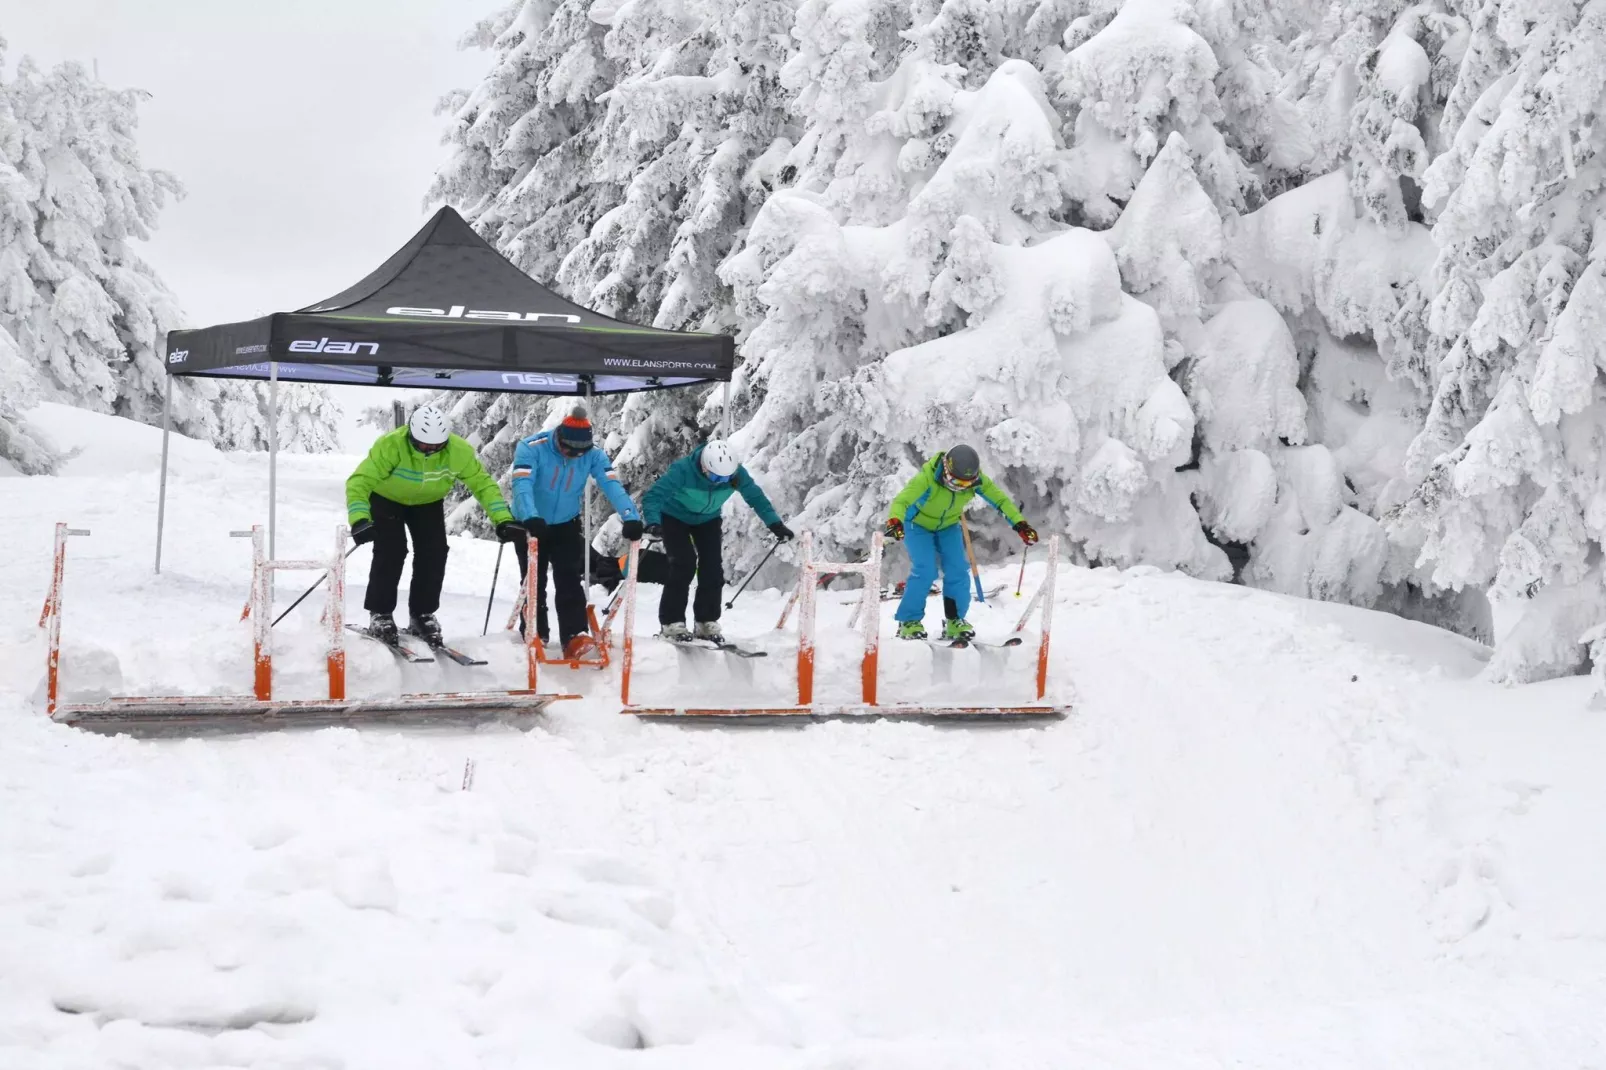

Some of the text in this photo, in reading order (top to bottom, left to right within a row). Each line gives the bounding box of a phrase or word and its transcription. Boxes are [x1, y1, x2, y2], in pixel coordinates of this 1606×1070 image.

[386, 306, 581, 323] elan
[288, 337, 380, 355] elan
[169, 348, 189, 364] elan
